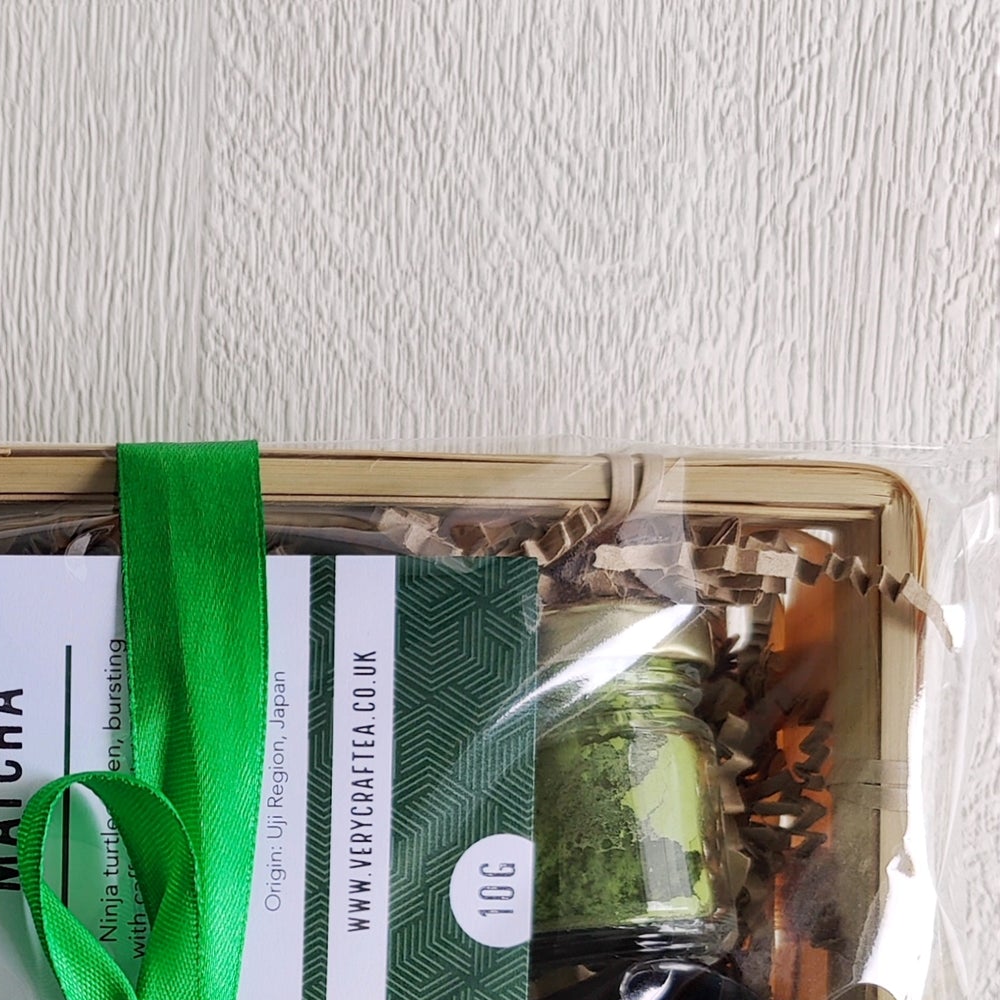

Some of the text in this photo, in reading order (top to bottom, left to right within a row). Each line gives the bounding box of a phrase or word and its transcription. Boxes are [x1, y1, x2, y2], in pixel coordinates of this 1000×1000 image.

[101, 639, 127, 731] bursting
[264, 671, 290, 912] Origin: Uji Region, Japan
[346, 650, 378, 933] WWW.VERYCRAFTEA.CO.UK
[100, 817, 120, 877] turtle
[99, 884, 124, 943] Ninja
[476, 862, 516, 918] 10G
[127, 913, 147, 959] with
